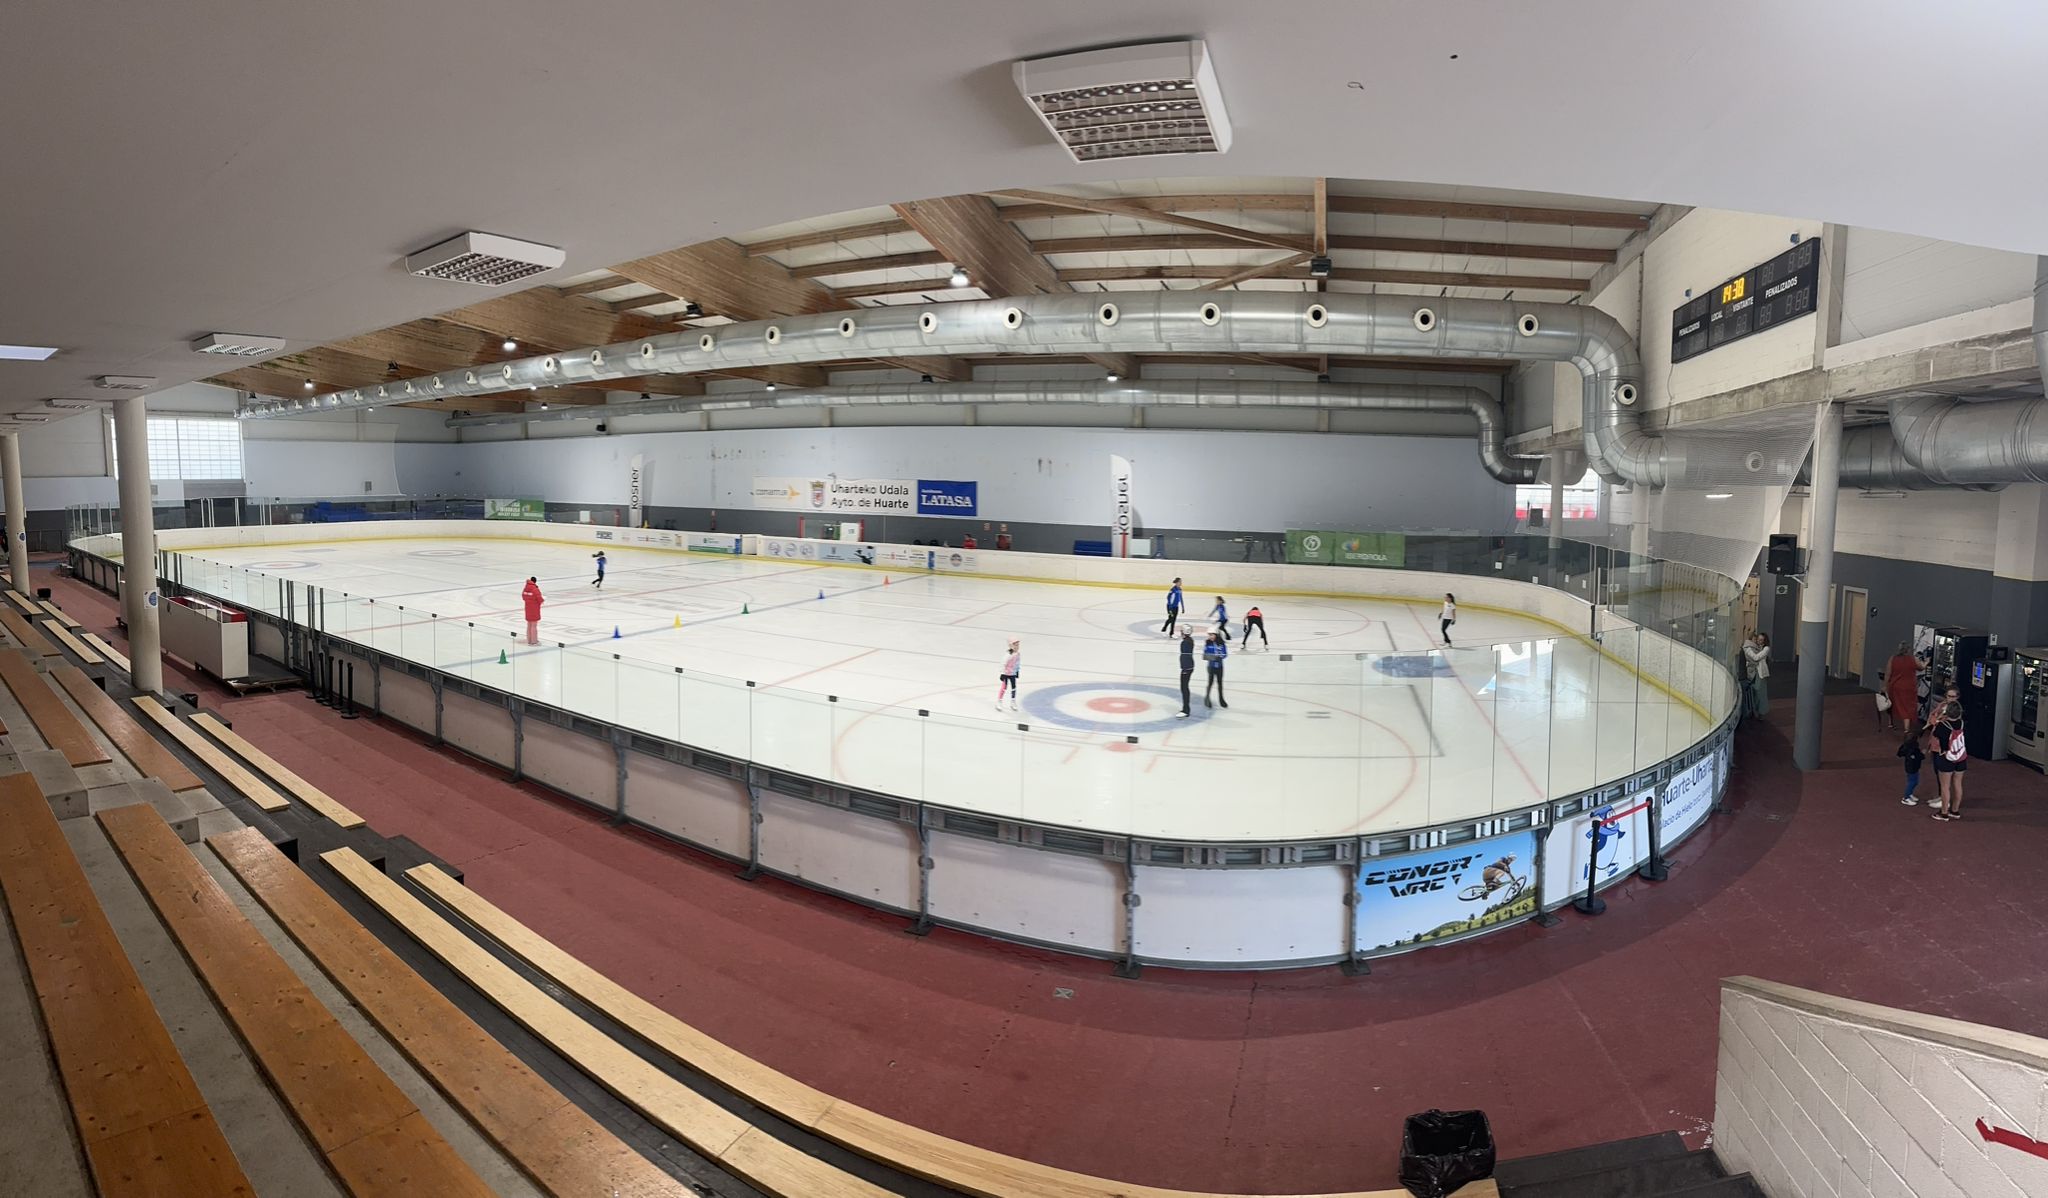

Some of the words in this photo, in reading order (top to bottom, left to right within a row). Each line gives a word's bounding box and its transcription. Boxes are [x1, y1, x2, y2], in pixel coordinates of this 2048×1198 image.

[1765, 275, 1798, 299] PENALIZADOS
[831, 484, 876, 494] Uharteko
[879, 484, 909, 495] Udala
[858, 498, 871, 507] de
[874, 498, 909, 508] Huarte
[920, 494, 974, 508] LATASA
[1388, 876, 1447, 898] WRC
